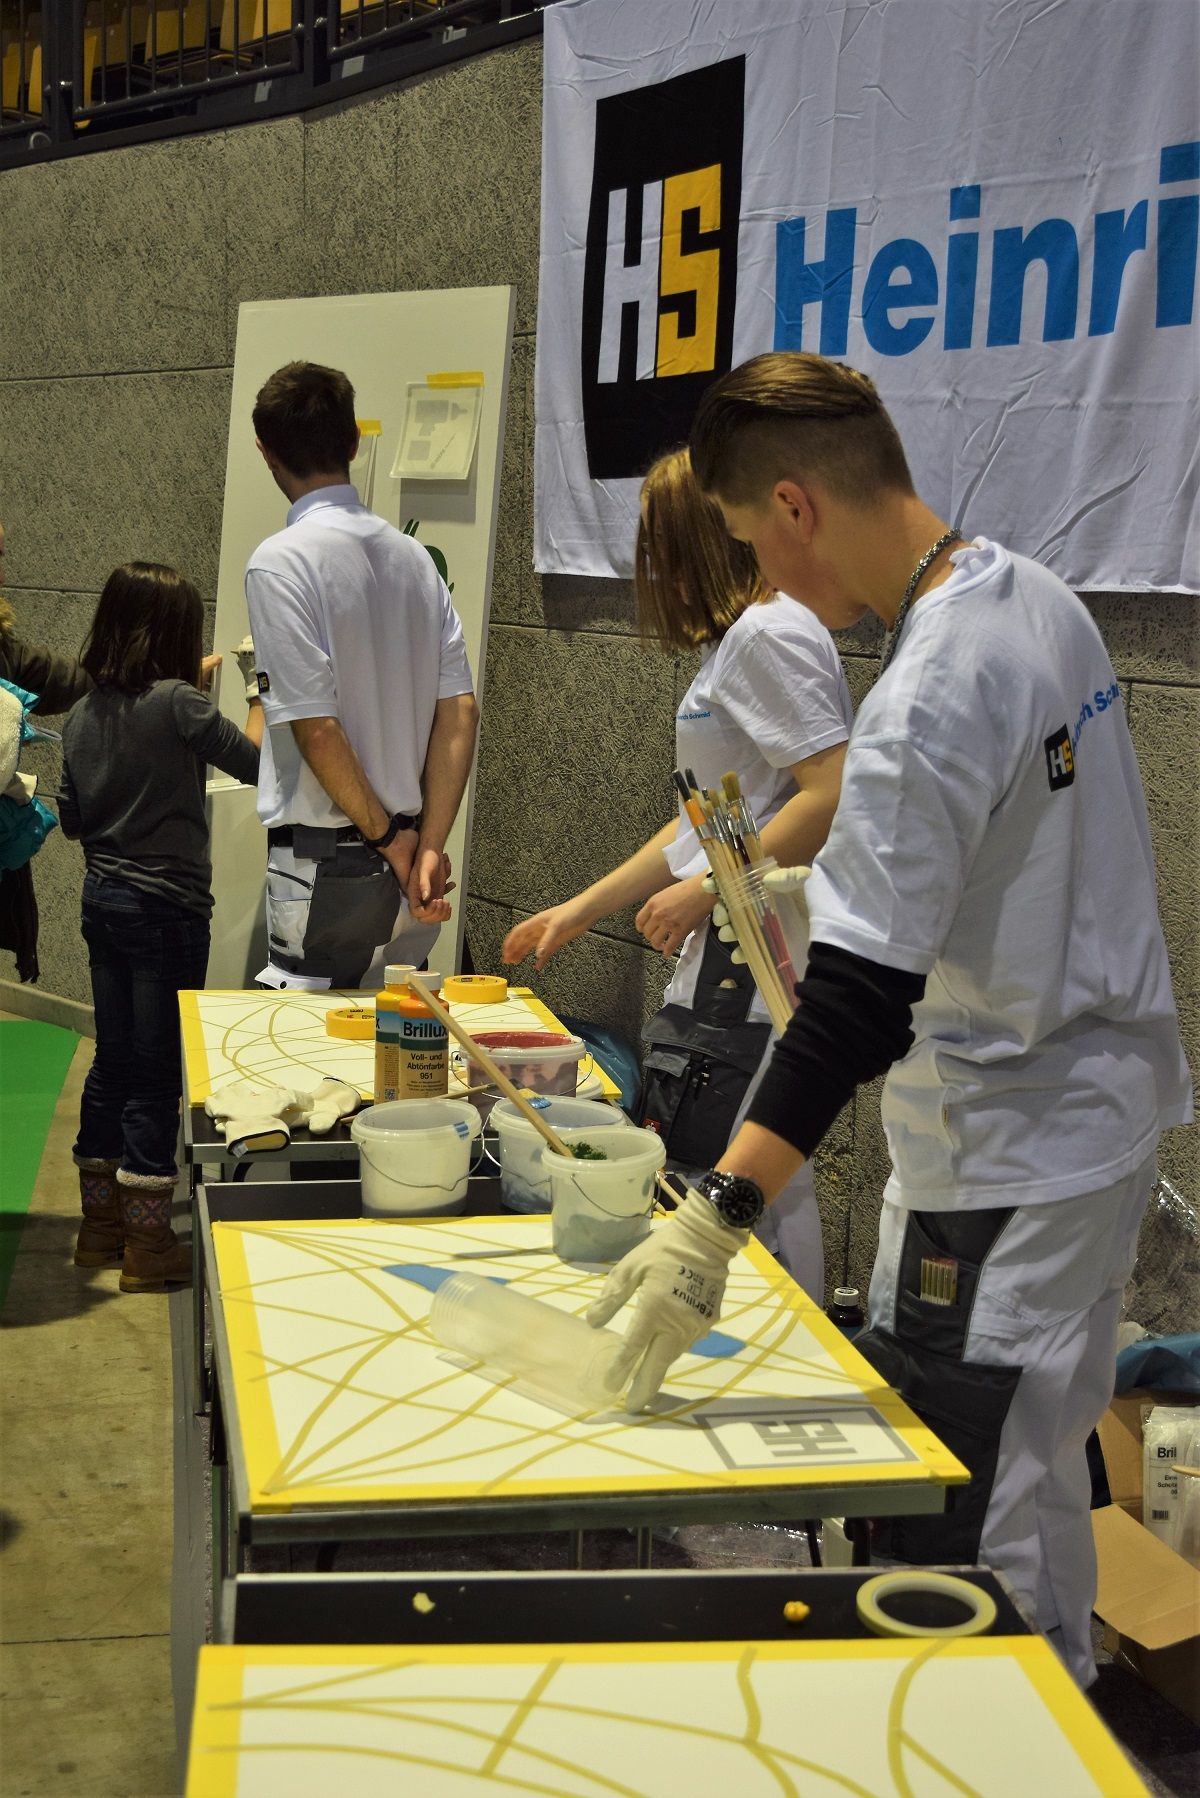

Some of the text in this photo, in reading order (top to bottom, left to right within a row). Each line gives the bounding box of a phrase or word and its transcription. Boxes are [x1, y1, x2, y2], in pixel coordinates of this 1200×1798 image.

[597, 142, 1200, 384] HS Heinri
[1050, 738, 1073, 779] HS
[403, 1022, 447, 1038] Brillux
[407, 1062, 444, 1070] Abtönfarbe
[672, 1287, 707, 1315] Brillux
